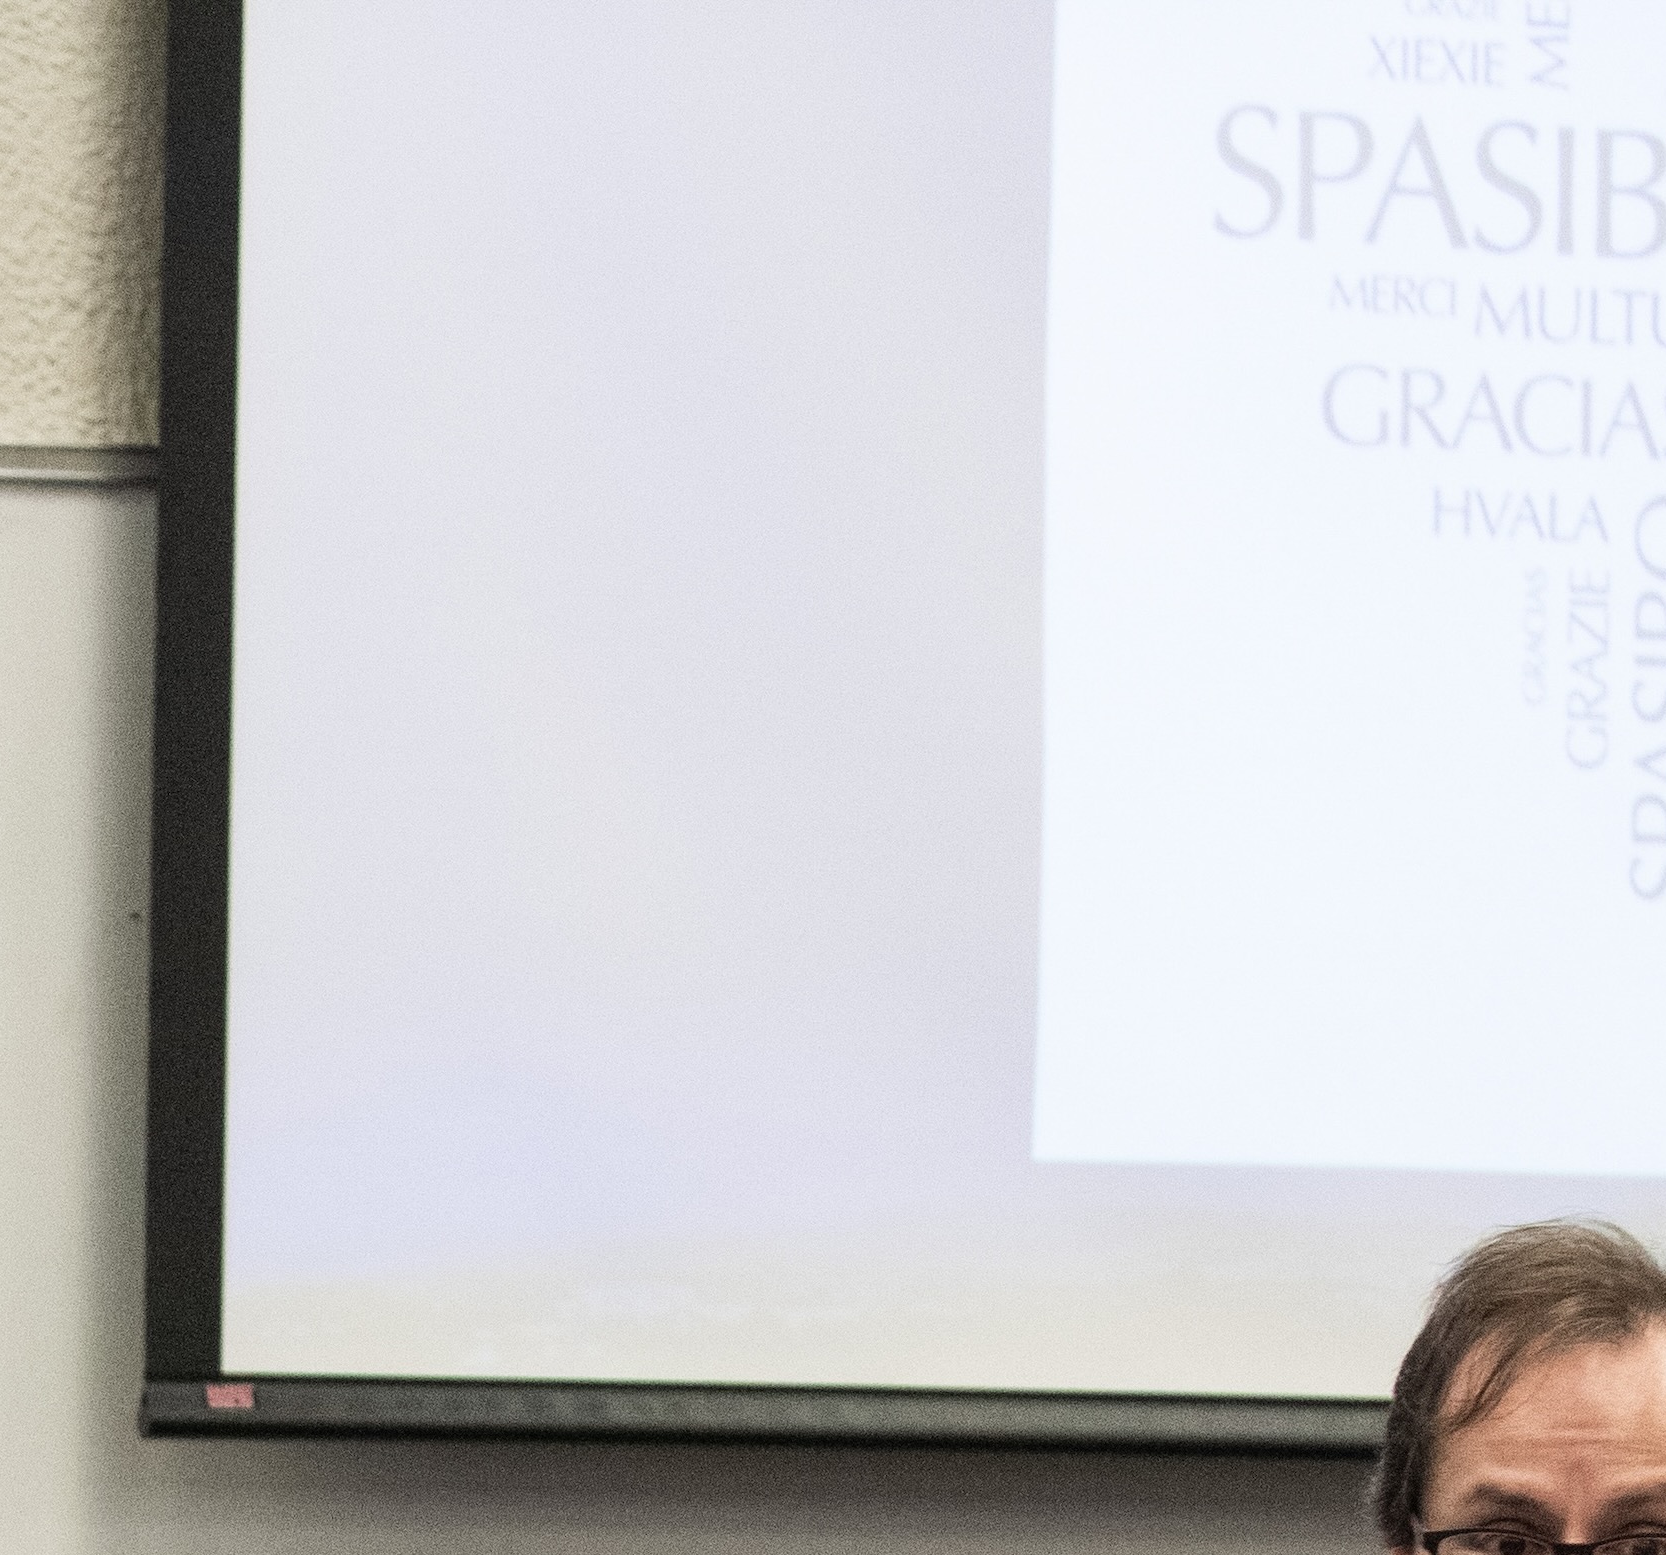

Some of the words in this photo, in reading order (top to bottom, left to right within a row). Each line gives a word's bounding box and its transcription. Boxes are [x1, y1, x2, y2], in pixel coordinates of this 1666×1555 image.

[1368, 35, 1506, 88] XIEXIE
[1329, 273, 1458, 318] MERCI
[1432, 487, 1610, 544] HVALA
[1564, 565, 1611, 772] GRAZIE
